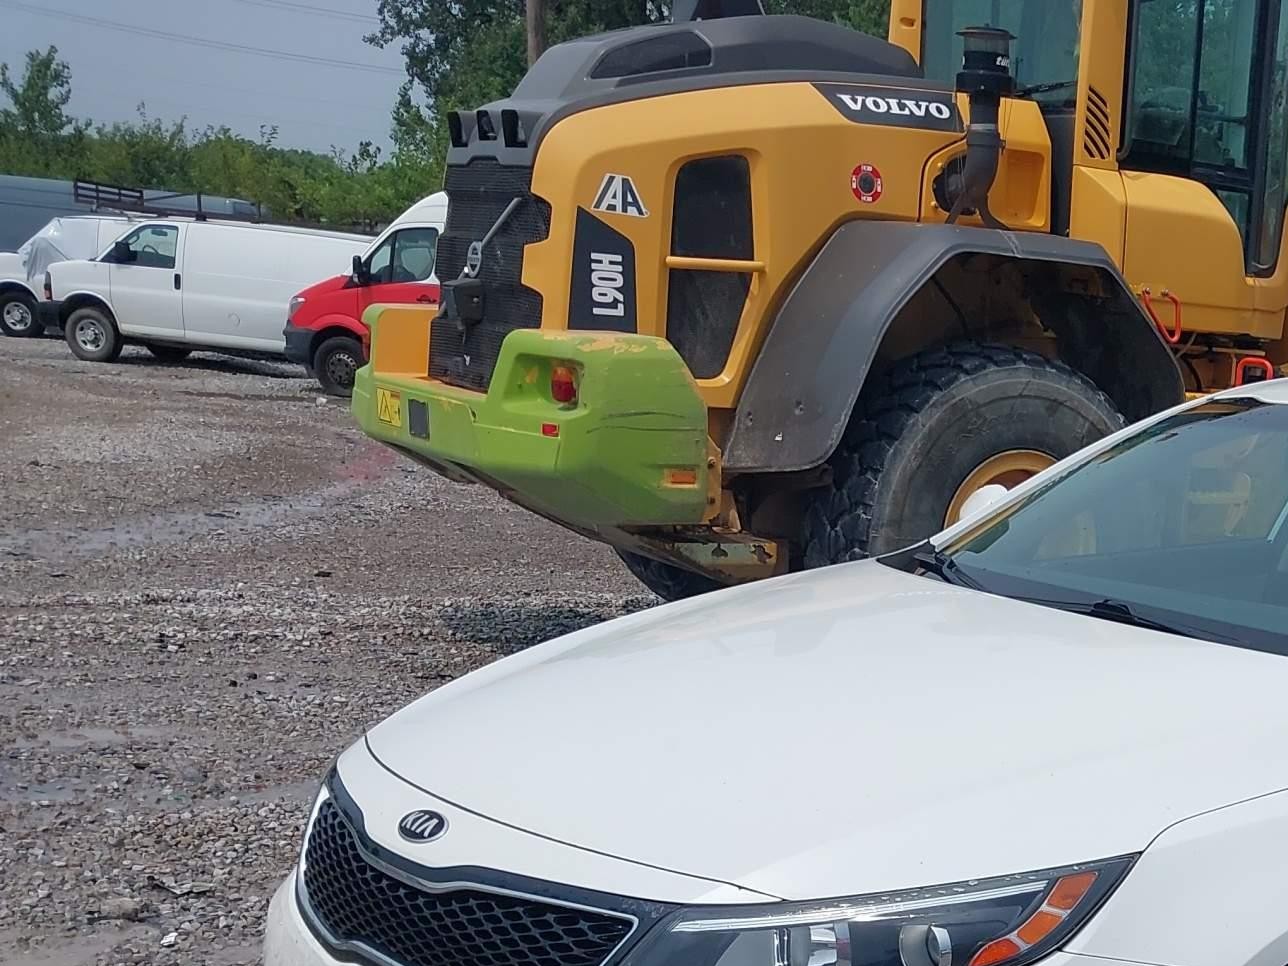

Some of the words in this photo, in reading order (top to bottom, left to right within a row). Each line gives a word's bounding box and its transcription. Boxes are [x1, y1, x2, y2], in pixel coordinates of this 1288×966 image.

[836, 93, 951, 120] VOLVO
[590, 252, 625, 317] L90H
[401, 811, 440, 838] KIA
